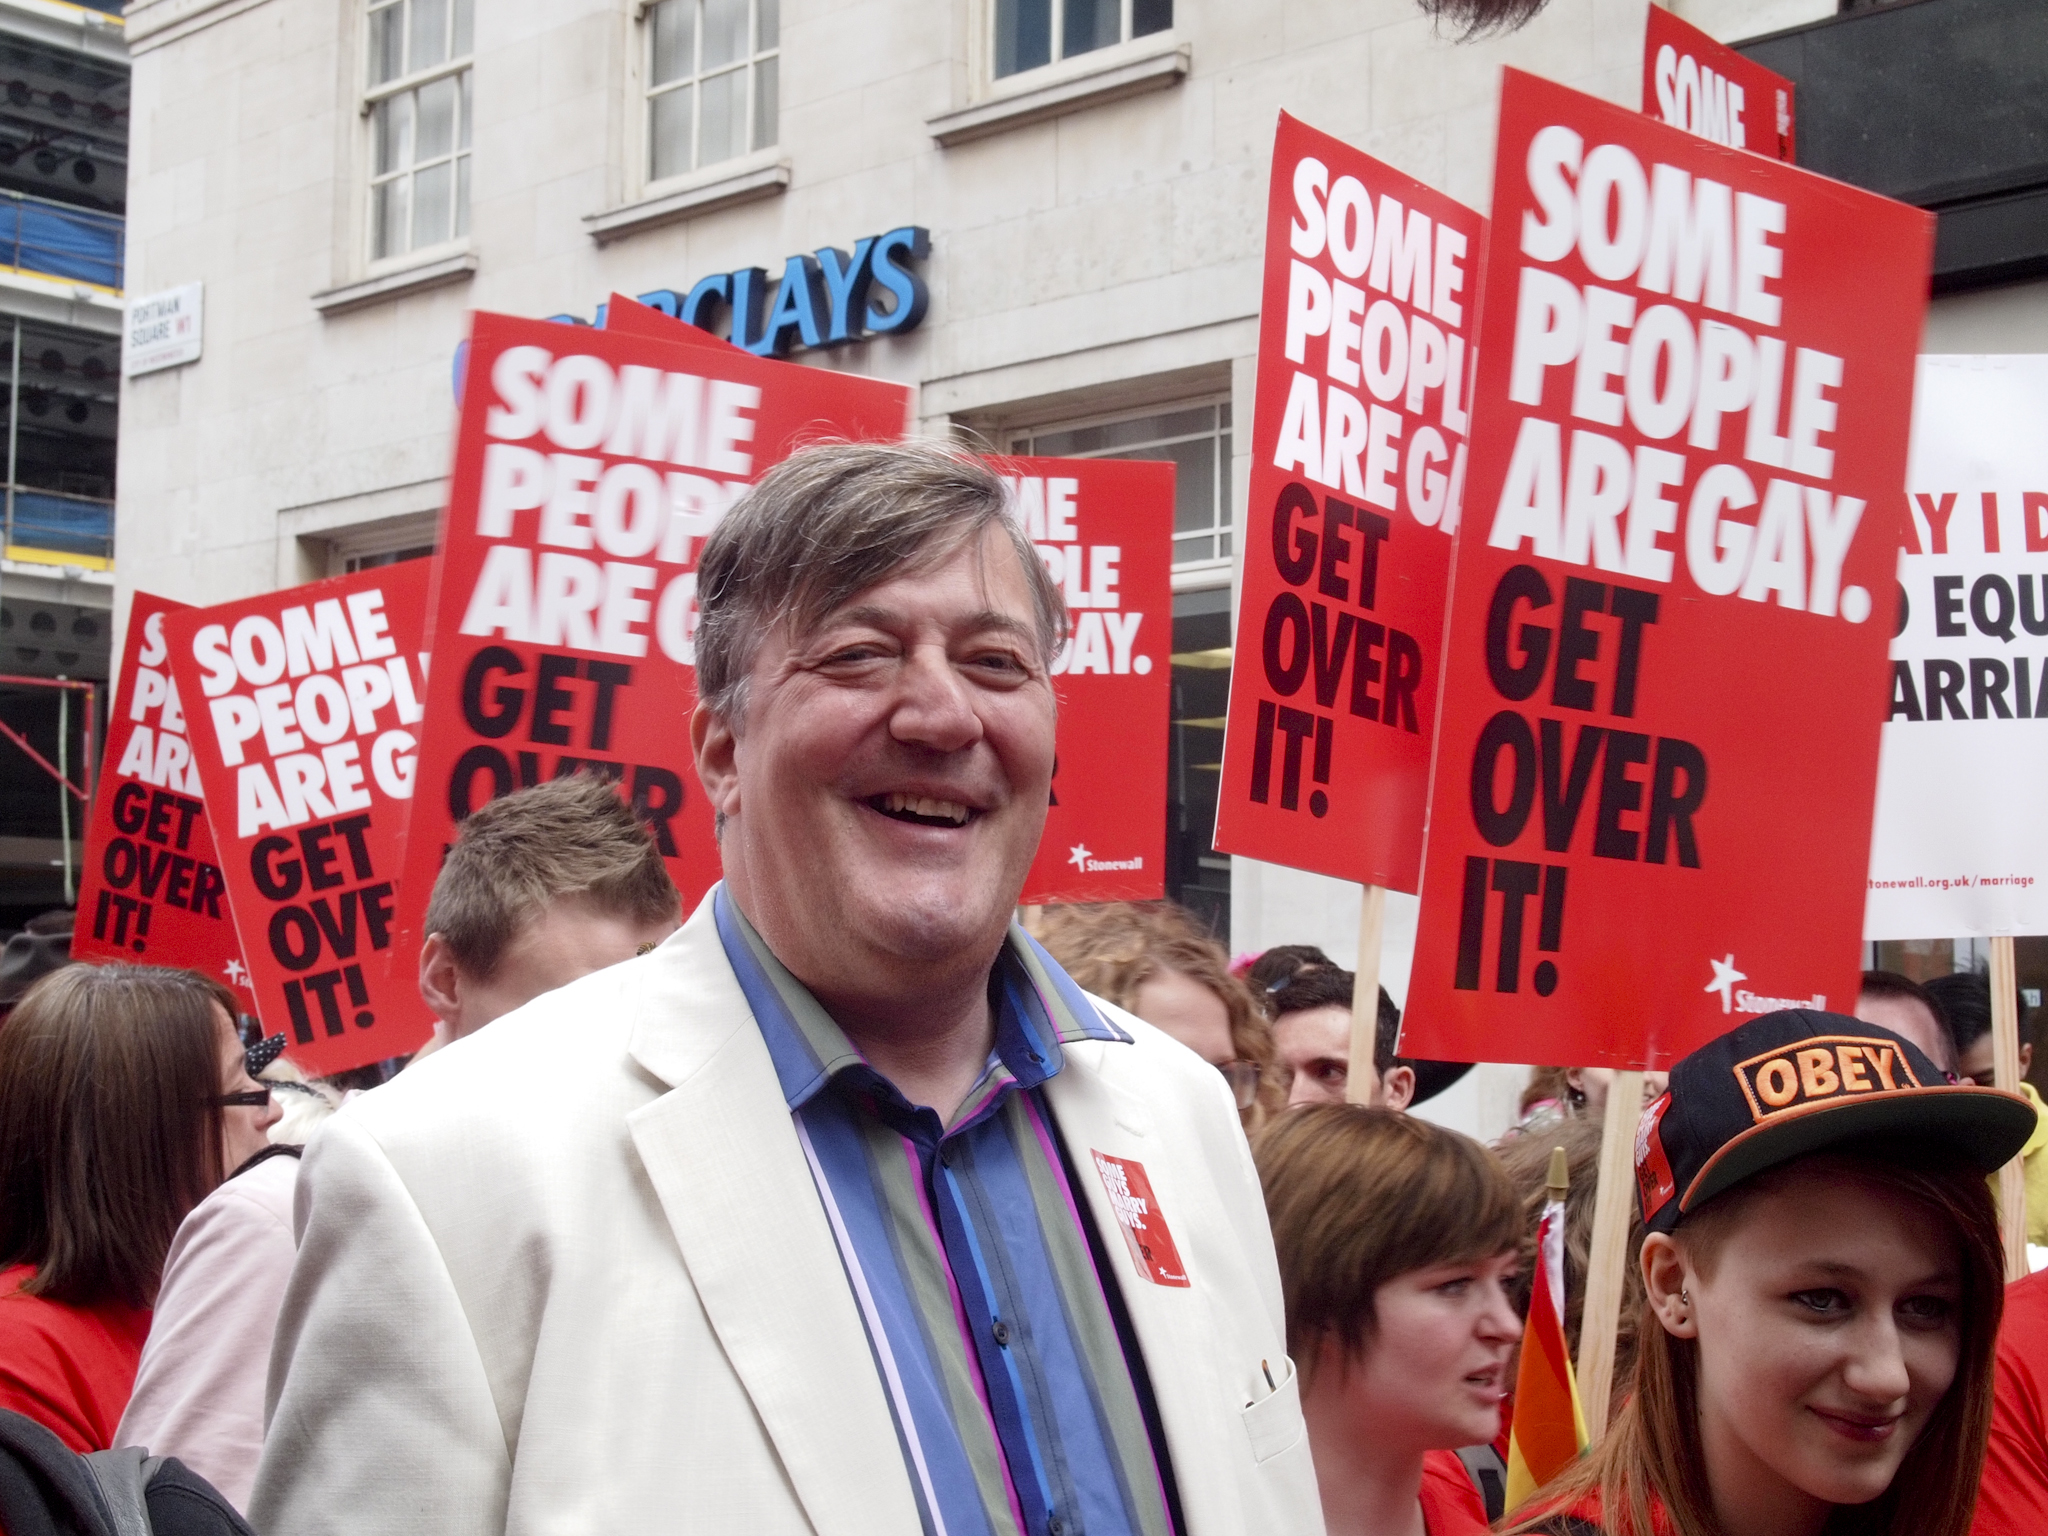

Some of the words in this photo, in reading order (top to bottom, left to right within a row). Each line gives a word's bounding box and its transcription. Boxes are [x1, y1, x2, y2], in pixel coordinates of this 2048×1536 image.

[1655, 44, 1746, 149] SOME
[1290, 157, 1467, 328] SOME
[1519, 125, 1787, 328] SOME
[132, 319, 170, 348] SQUARE
[543, 226, 927, 356] CLAYS
[1285, 258, 1472, 438] PEOPL
[1508, 266, 1845, 480] PEOPLE
[485, 346, 762, 475] SOME
[1273, 371, 1403, 511] ARE
[476, 444, 748, 564] PEOP
[1272, 482, 1391, 611] GET
[1487, 417, 1687, 583] ARE
[1685, 463, 1872, 625] GAY.
[1981, 492, 2000, 553] I
[192, 589, 397, 698] SOME
[460, 545, 658, 657] ARE
[1484, 564, 1661, 718] GET
[1933, 573, 2048, 644] EQU
[209, 652, 430, 767] PEOPL
[460, 646, 632, 752] GET
[1262, 591, 1423, 735] OVER
[237, 741, 372, 838] ARE
[1250, 699, 1334, 819] IT!
[1470, 709, 1709, 870] OVER
[112, 782, 203, 851] GET
[250, 814, 374, 901] GET
[1086, 857, 1143, 871] Stonewall
[92, 891, 153, 954] IT!
[103, 838, 228, 920] OVER
[268, 879, 397, 971] OVE
[1454, 855, 1568, 998] IT!
[1867, 874, 2034, 890] tonewall.org.uk/marriage
[283, 963, 375, 1045] IT!
[1755, 1046, 1899, 1106] OBEY
[1096, 1157, 1127, 1181] SOME
[1102, 1174, 1130, 1197] GUYS
[1108, 1190, 1148, 1214] MARRY
[1114, 1205, 1147, 1230] GUYS.
